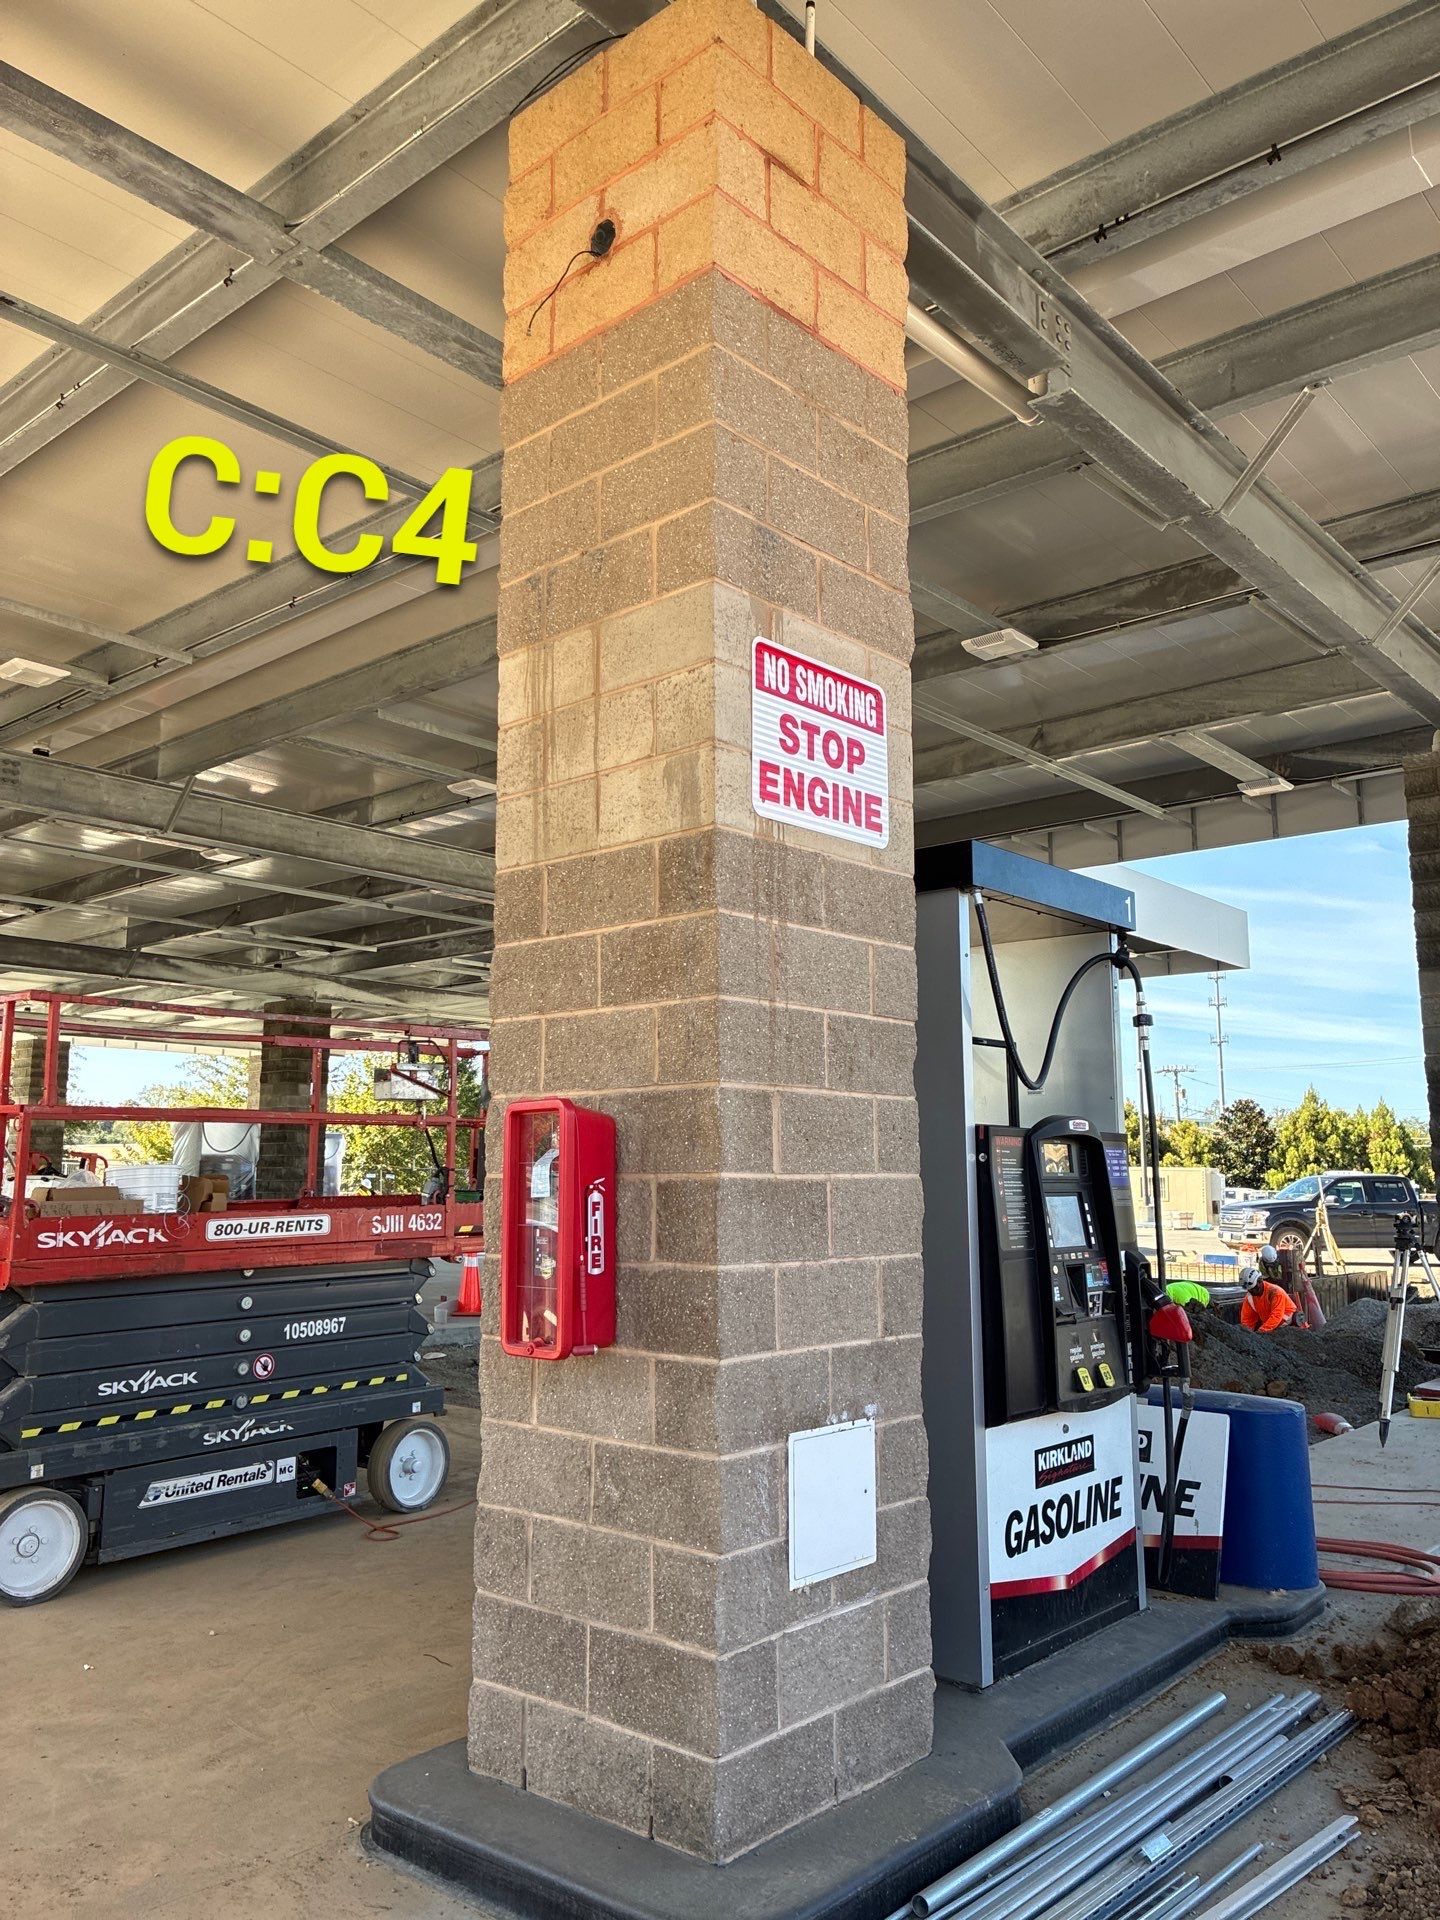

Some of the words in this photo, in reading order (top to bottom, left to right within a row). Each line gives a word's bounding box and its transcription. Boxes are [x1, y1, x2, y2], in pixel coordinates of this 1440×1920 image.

[763, 651, 790, 695] NO
[795, 664, 877, 727] SMOKING
[779, 713, 865, 774] STOP
[759, 759, 883, 833] ENGINE
[1125, 896, 1131, 922] 1
[995, 1136, 1022, 1147] WARNING
[37, 1220, 169, 1249] SKYJACK
[214, 1219, 324, 1236] 800-UR-RENTS
[408, 1213, 443, 1232] 4632
[591, 1201, 601, 1269] FIRE
[283, 1317, 346, 1340] 10508967
[97, 1369, 199, 1396] SKYJACK
[1038, 1440, 1093, 1471] KIRKLAND
[164, 1477, 216, 1498] United
[217, 1467, 268, 1489] Rentals
[1005, 1475, 1123, 1558] GASOLINE
